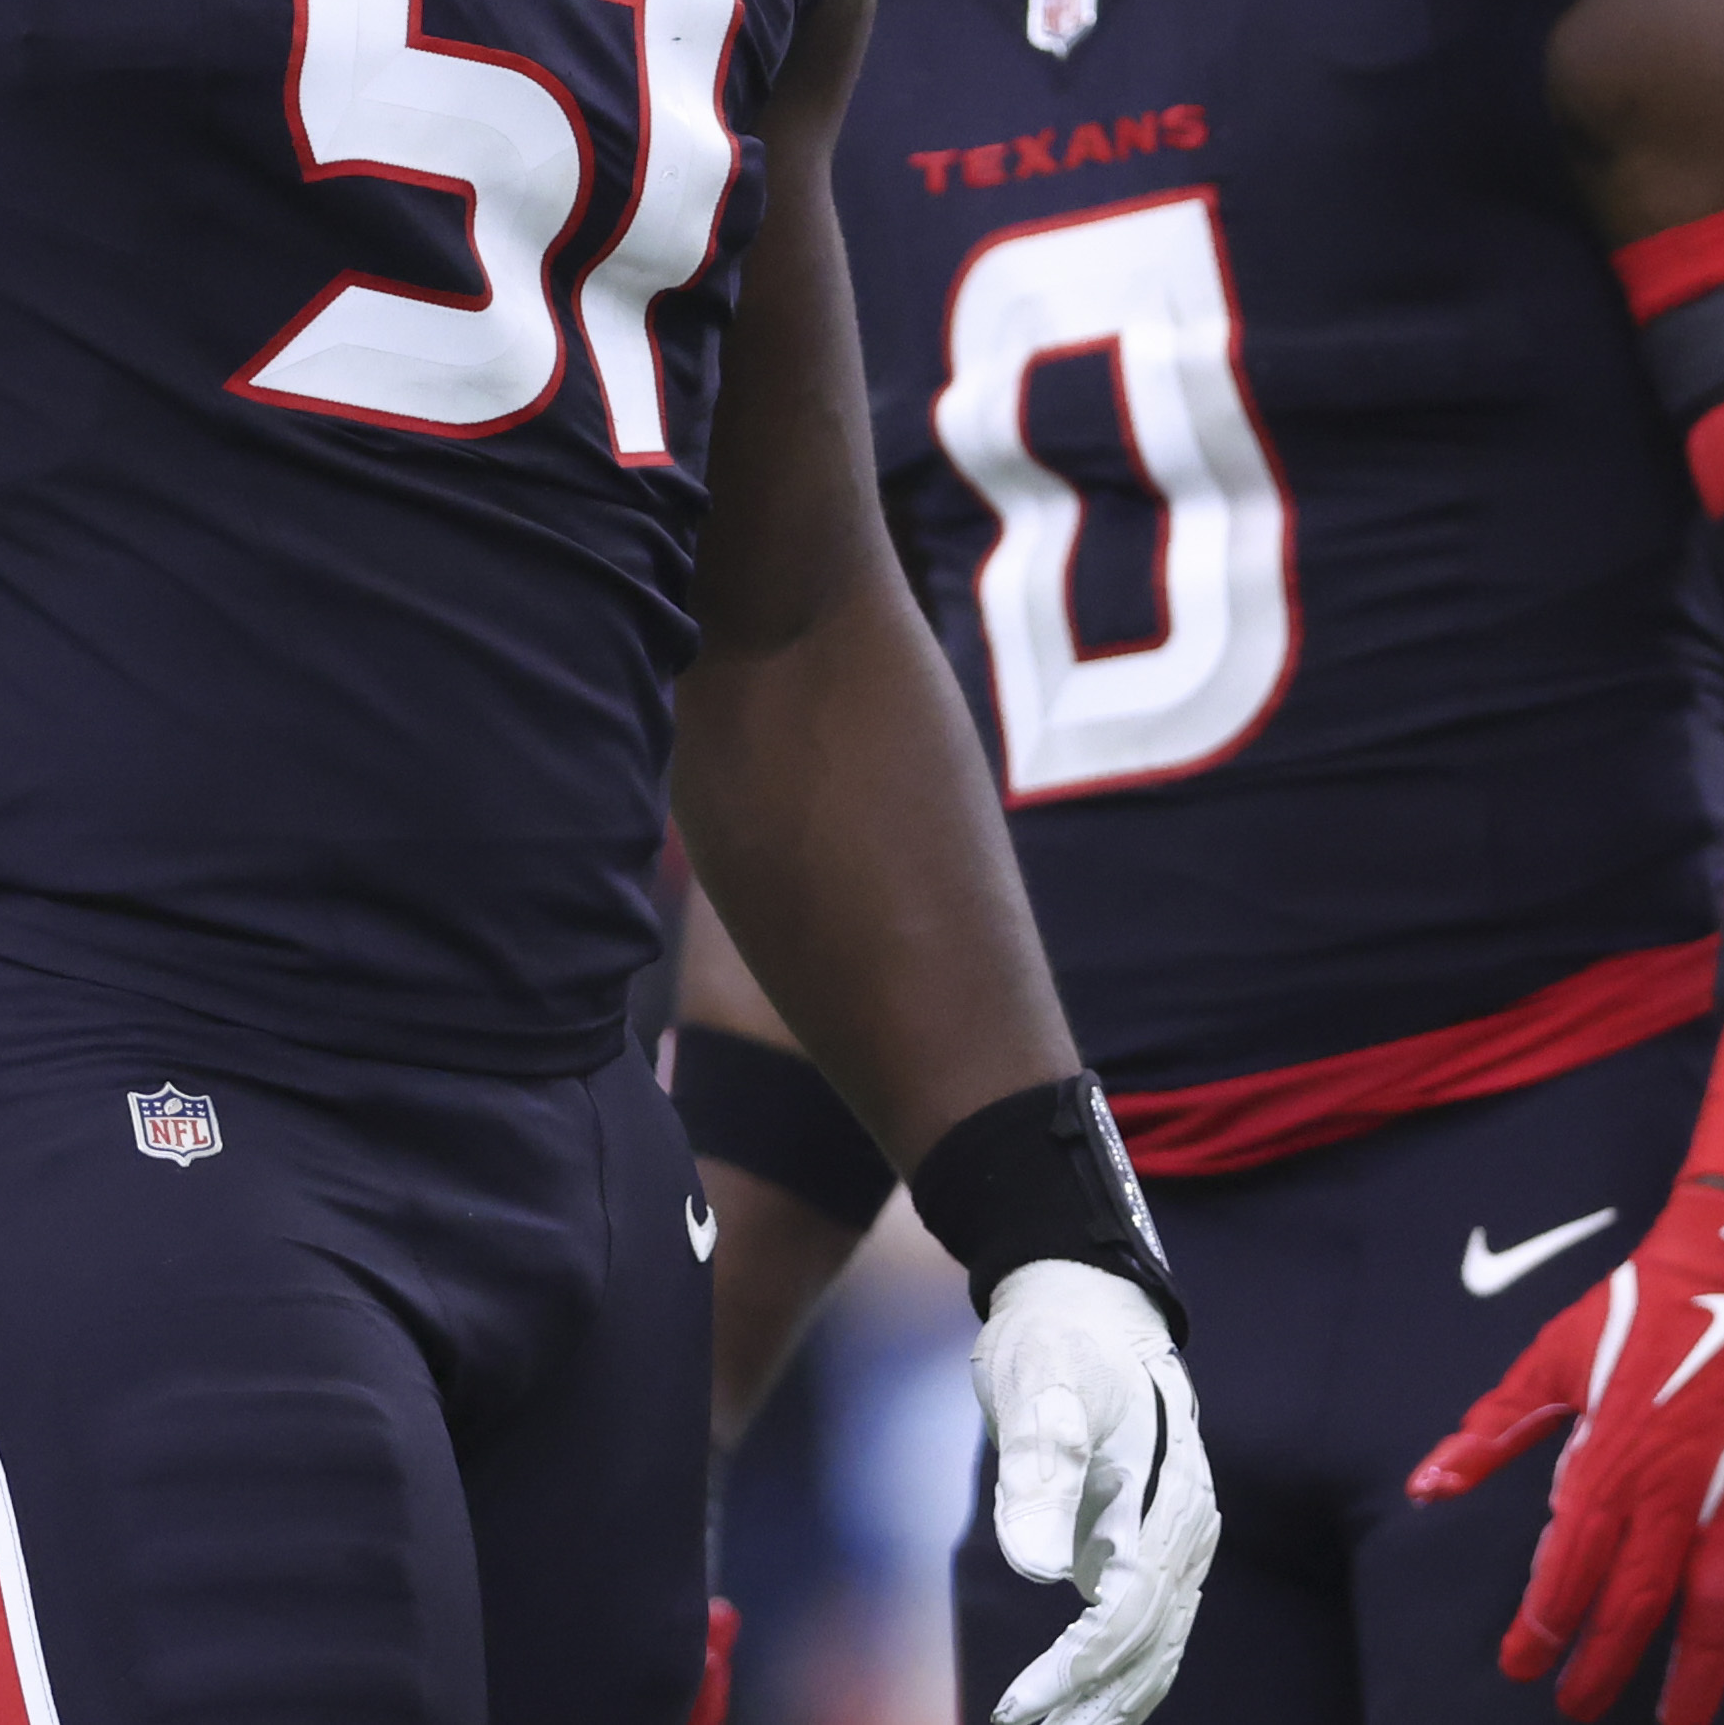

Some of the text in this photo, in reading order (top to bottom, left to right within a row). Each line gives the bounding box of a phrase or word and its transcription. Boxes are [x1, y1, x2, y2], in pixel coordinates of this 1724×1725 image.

[910, 103, 1209, 196] TEXANS
[931, 183, 1303, 809] 0
[148, 1119, 208, 1148] NFL
